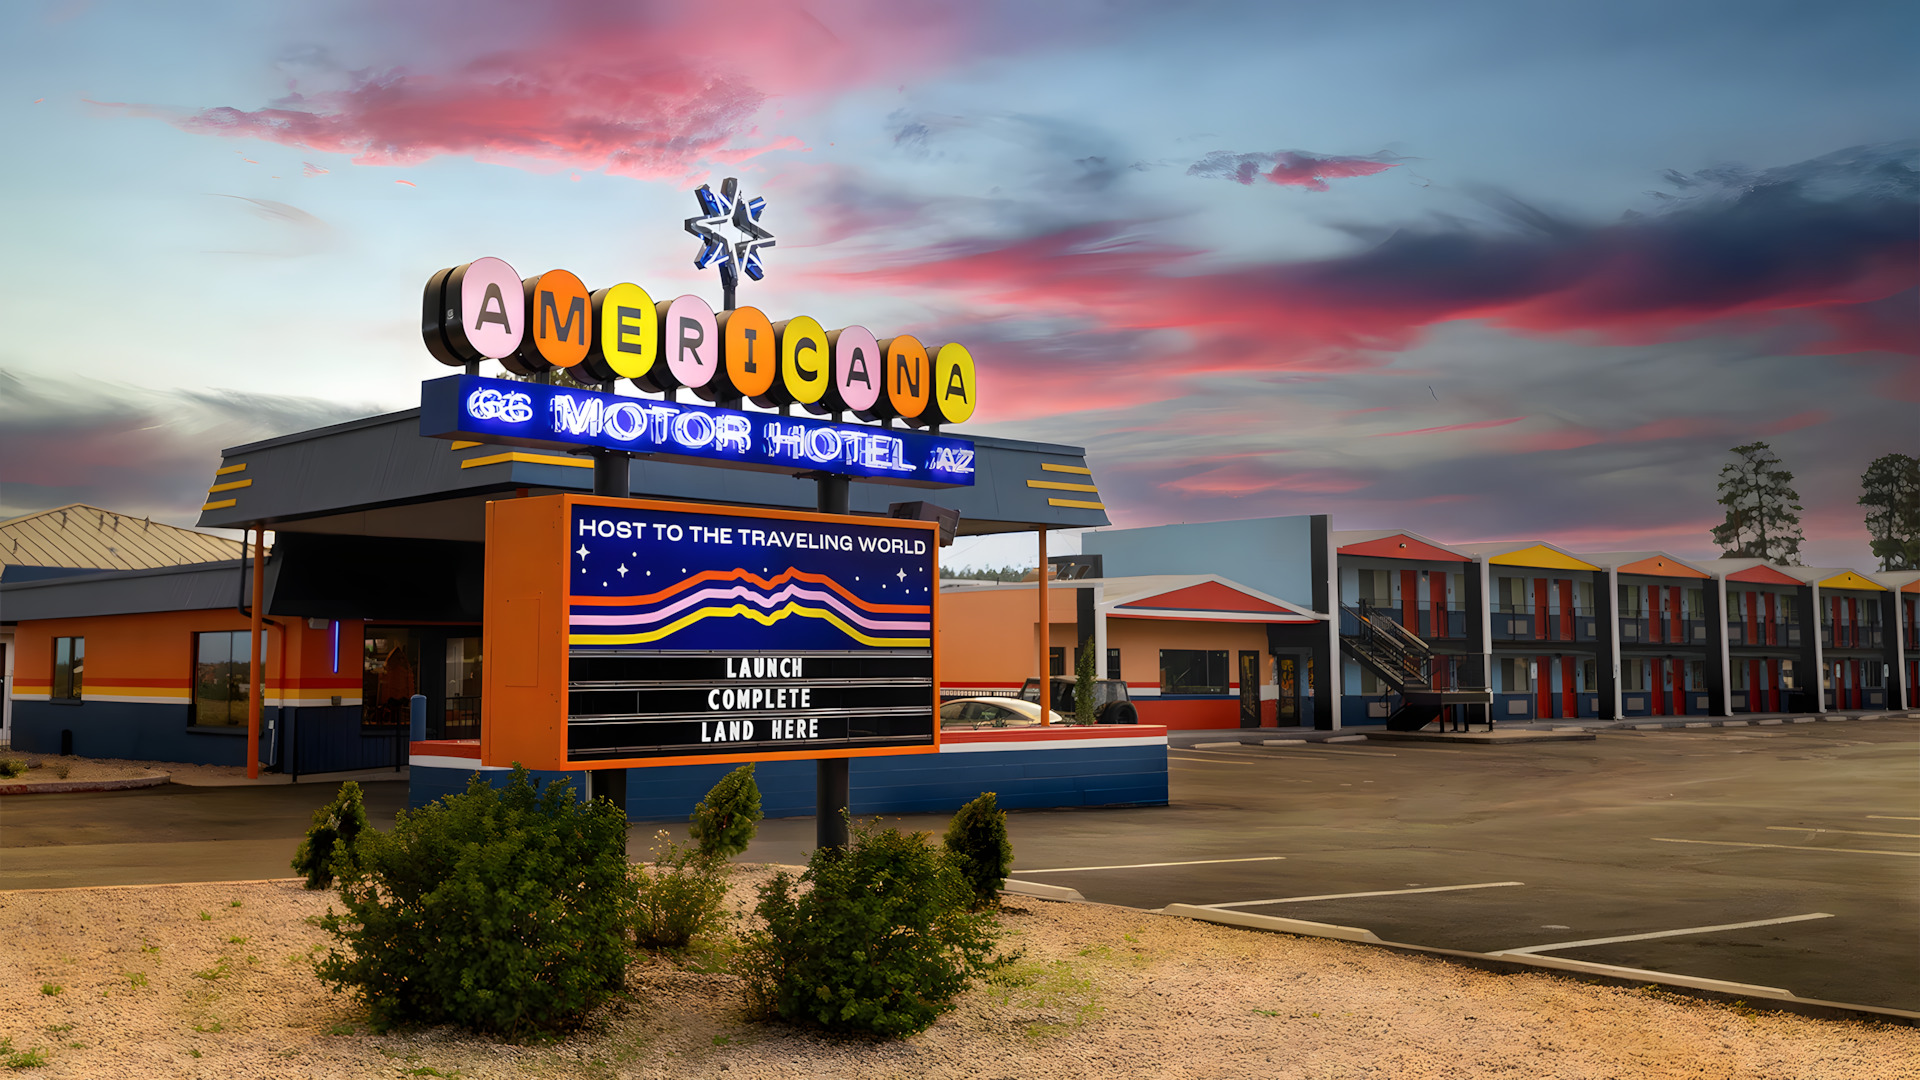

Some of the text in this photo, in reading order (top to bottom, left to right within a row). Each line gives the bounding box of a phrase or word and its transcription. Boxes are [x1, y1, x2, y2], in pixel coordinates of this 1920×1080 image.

[475, 283, 968, 404] AMERICANA
[467, 387, 975, 473] 66 MOTOR HOTEL AZ
[579, 518, 927, 555] HOST TO THE TRAVELING WORLD
[726, 657, 803, 679] LAUNCH
[707, 688, 811, 711] COMPLETE
[701, 718, 819, 743] LAND HERE
